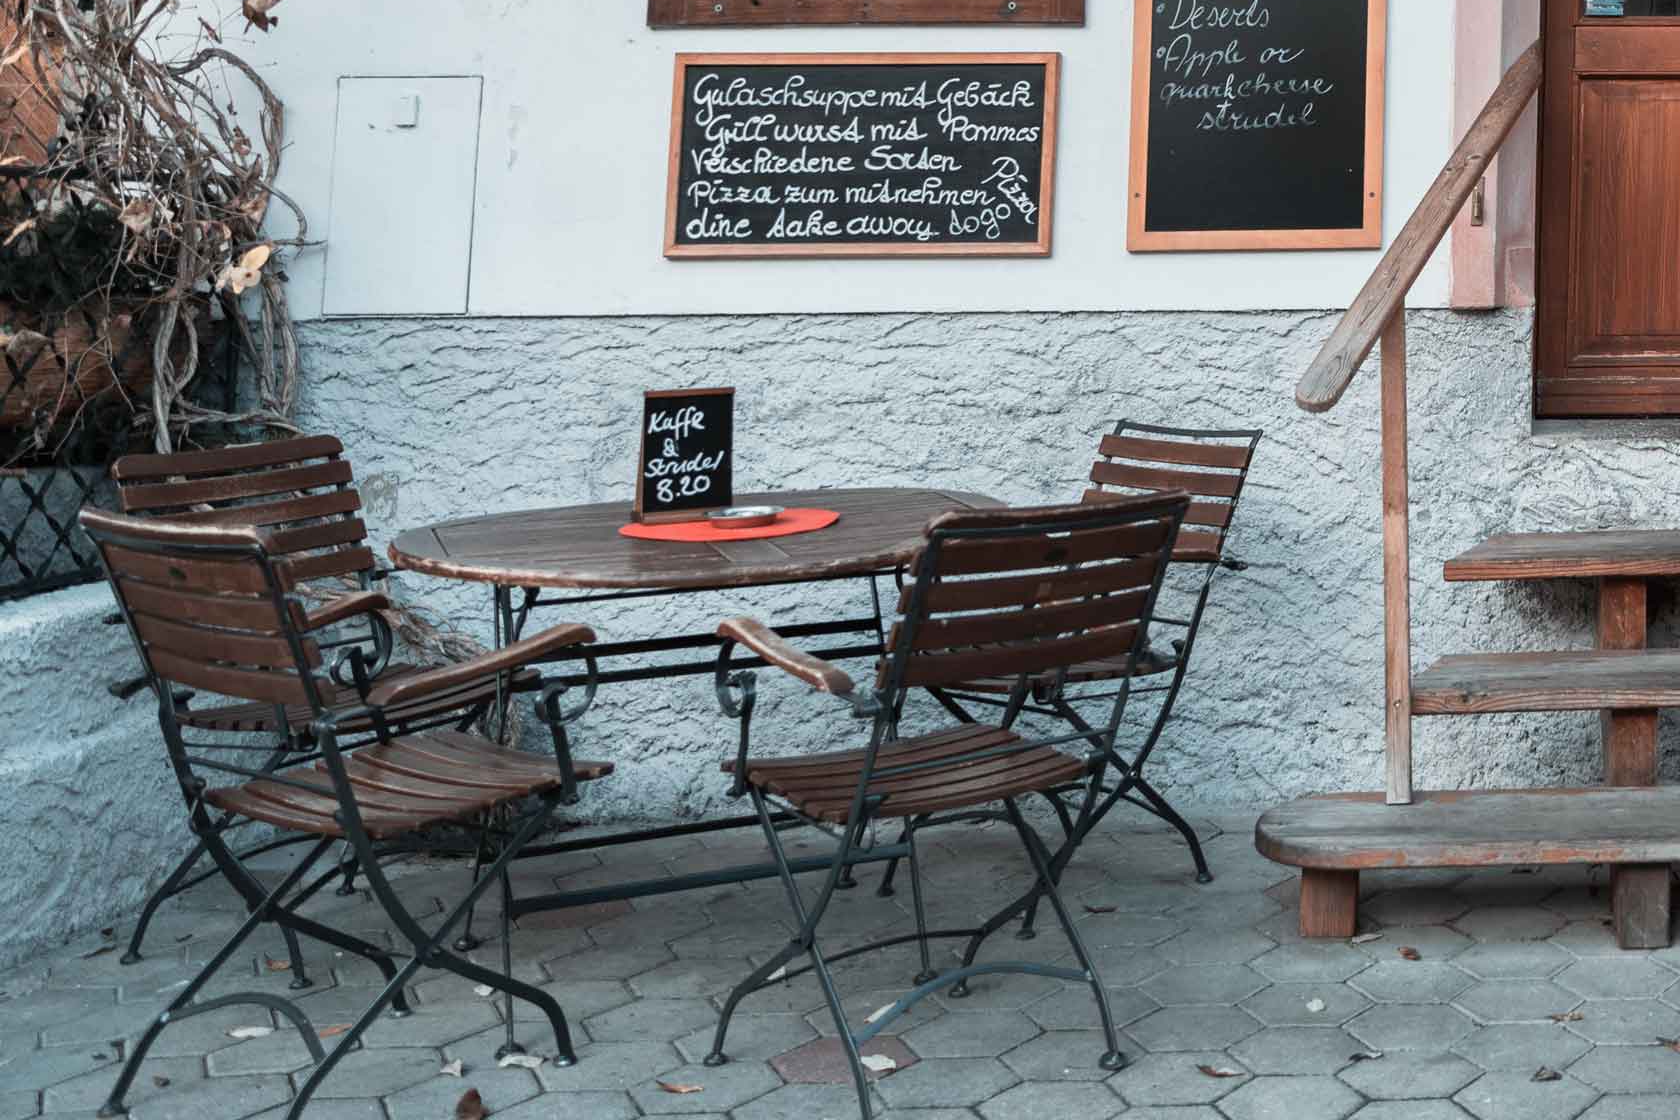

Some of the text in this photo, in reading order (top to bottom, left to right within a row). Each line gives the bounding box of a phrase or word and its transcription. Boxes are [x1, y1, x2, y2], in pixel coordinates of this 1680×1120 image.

[1163, 33, 1305, 77] Apple or
[693, 73, 1035, 127] Gulaschsuppe mit Gebäck
[1195, 99, 1318, 131] strudel
[871, 117, 929, 142] mit
[942, 115, 1041, 142] Pommes
[863, 145, 963, 172] Sorten
[687, 177, 997, 209] Pizza zum mitnehmen
[765, 207, 843, 239] take
[647, 406, 706, 440] Kaffe
[662, 437, 680, 457] &
[644, 450, 725, 478] Strudel
[656, 474, 711, 502] 8.20
